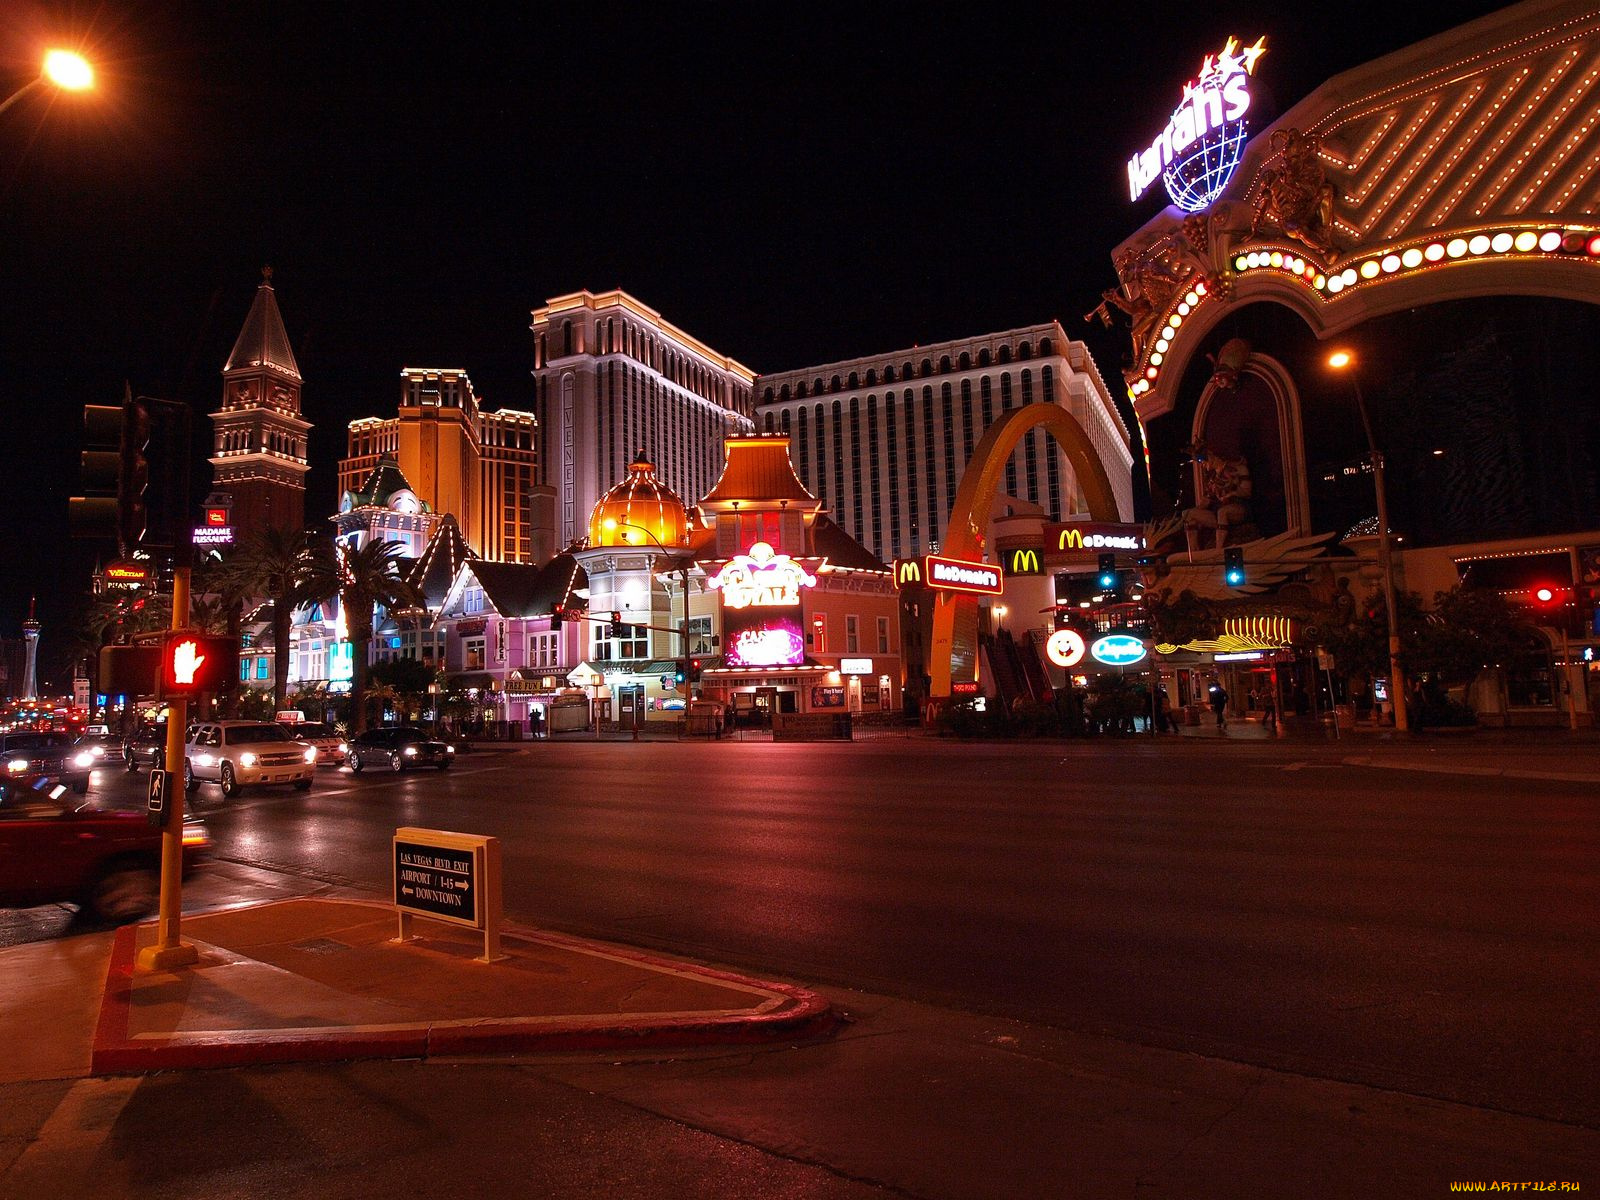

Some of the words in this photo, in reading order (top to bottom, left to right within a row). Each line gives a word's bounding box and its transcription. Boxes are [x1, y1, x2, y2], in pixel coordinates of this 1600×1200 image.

[194, 528, 232, 536] MADAME
[934, 564, 997, 586] McDonald's
[505, 681, 522, 689] FREE
[525, 681, 538, 689] FUN
[400, 852, 411, 862] LAS
[413, 854, 432, 867] VEGAS
[453, 860, 470, 873] EXIT
[401, 870, 431, 885] AIRPORT
[440, 876, 454, 889] I-15
[415, 887, 461, 906] DOWNTOWN
